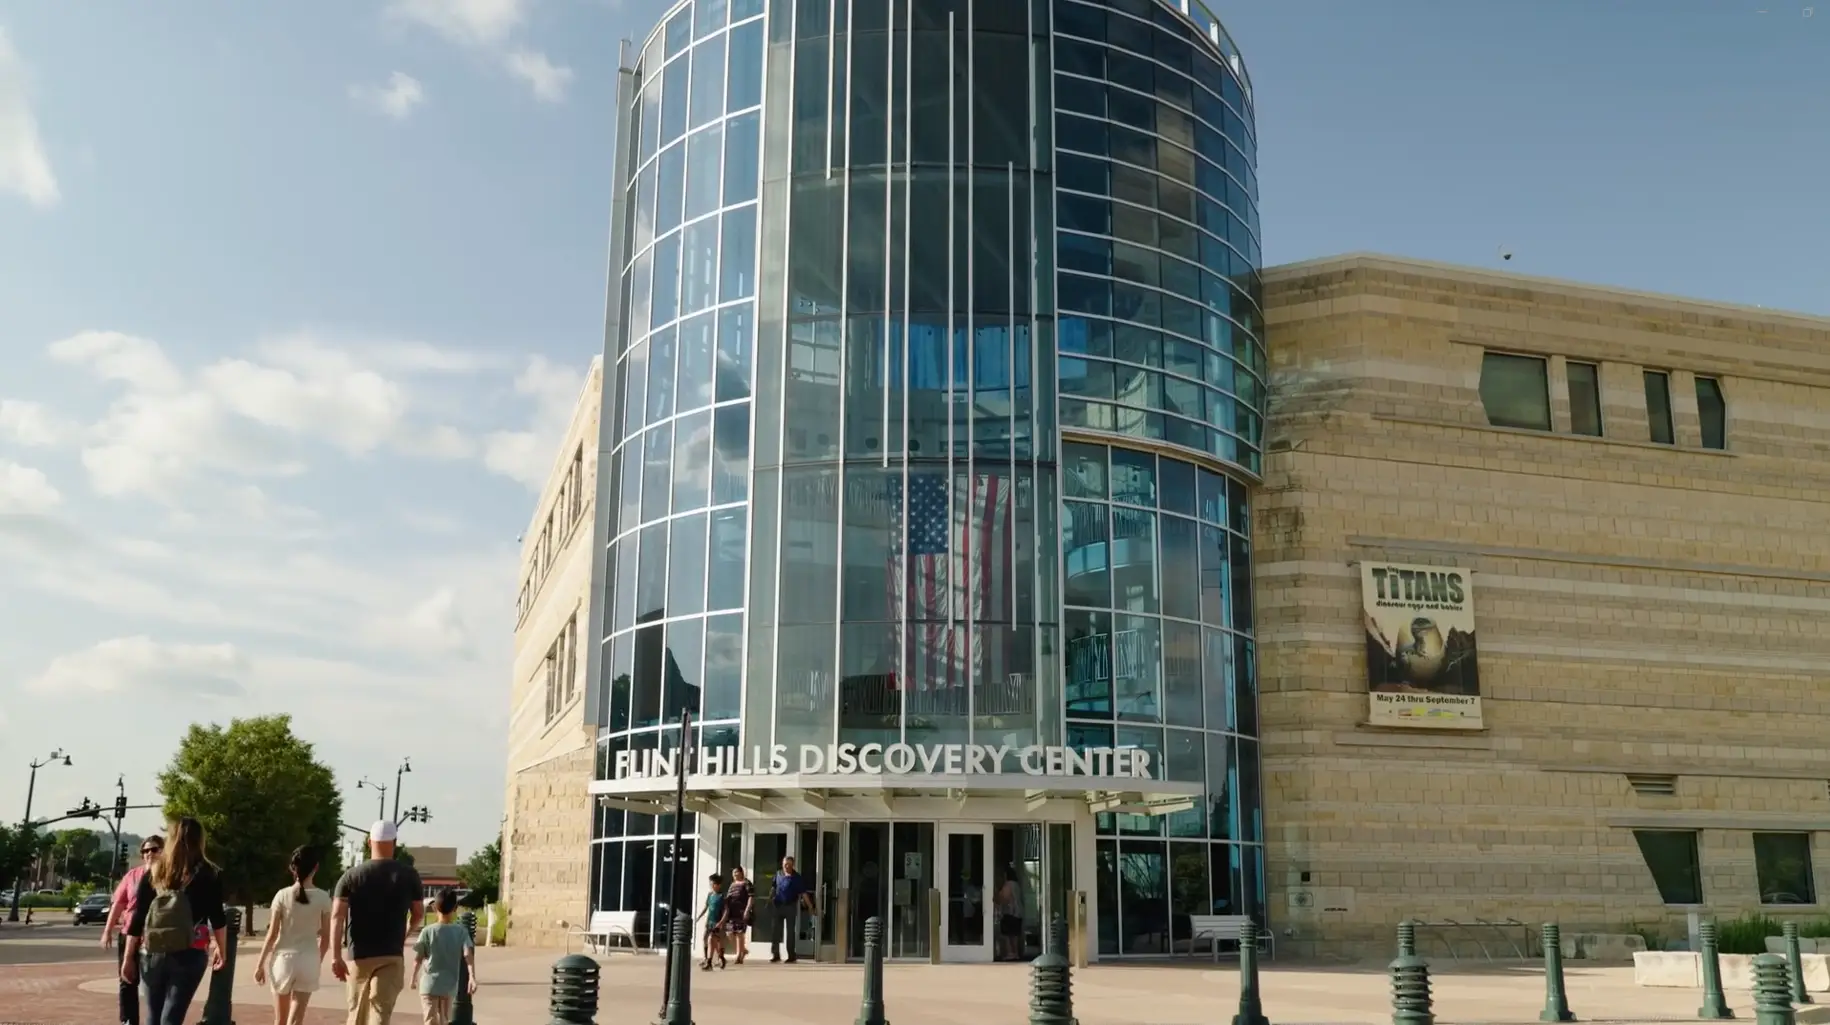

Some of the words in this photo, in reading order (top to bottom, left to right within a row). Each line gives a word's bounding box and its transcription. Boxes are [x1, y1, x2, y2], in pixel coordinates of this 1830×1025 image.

[1376, 694, 1394, 703] May
[1395, 694, 1406, 702] 24
[1407, 695, 1424, 703] thru
[1425, 696, 1469, 705] September
[702, 744, 788, 777] HILLS
[800, 742, 1010, 775] DISCOVERY
[1020, 743, 1153, 779] CENTER
